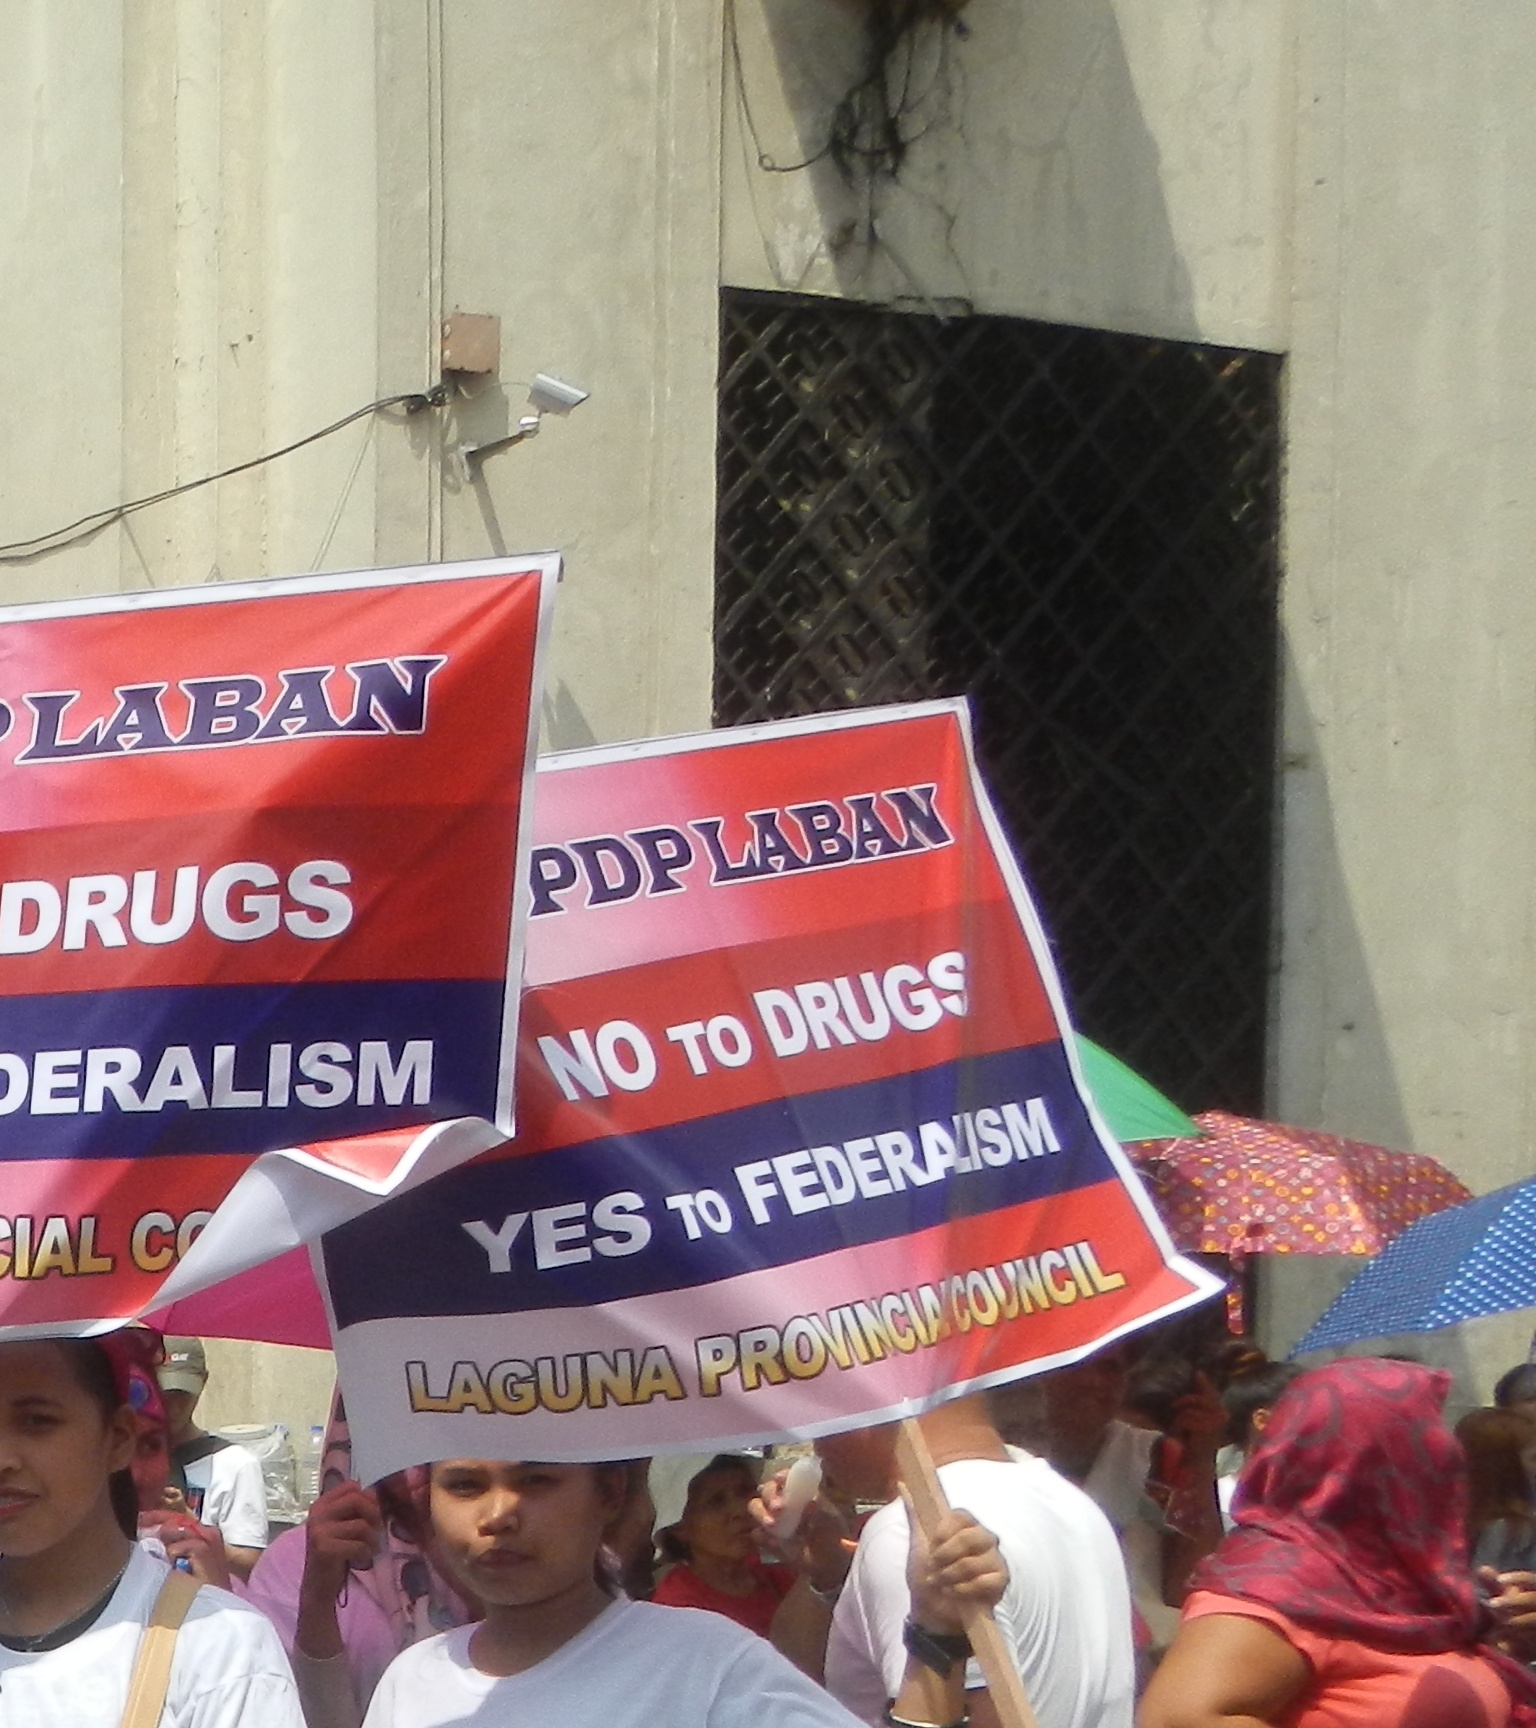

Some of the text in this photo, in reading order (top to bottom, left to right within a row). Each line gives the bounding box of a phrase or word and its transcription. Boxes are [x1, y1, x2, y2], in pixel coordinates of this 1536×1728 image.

[13, 654, 448, 766] LABAN
[528, 783, 955, 919] PDP LABAN
[536, 950, 969, 1102] NO TO DRUGS
[462, 1096, 1062, 1274] YES TO FEDERALISM
[406, 1345, 688, 1415] LAGUNA
[950, 1240, 1127, 1333] COUNCIL
